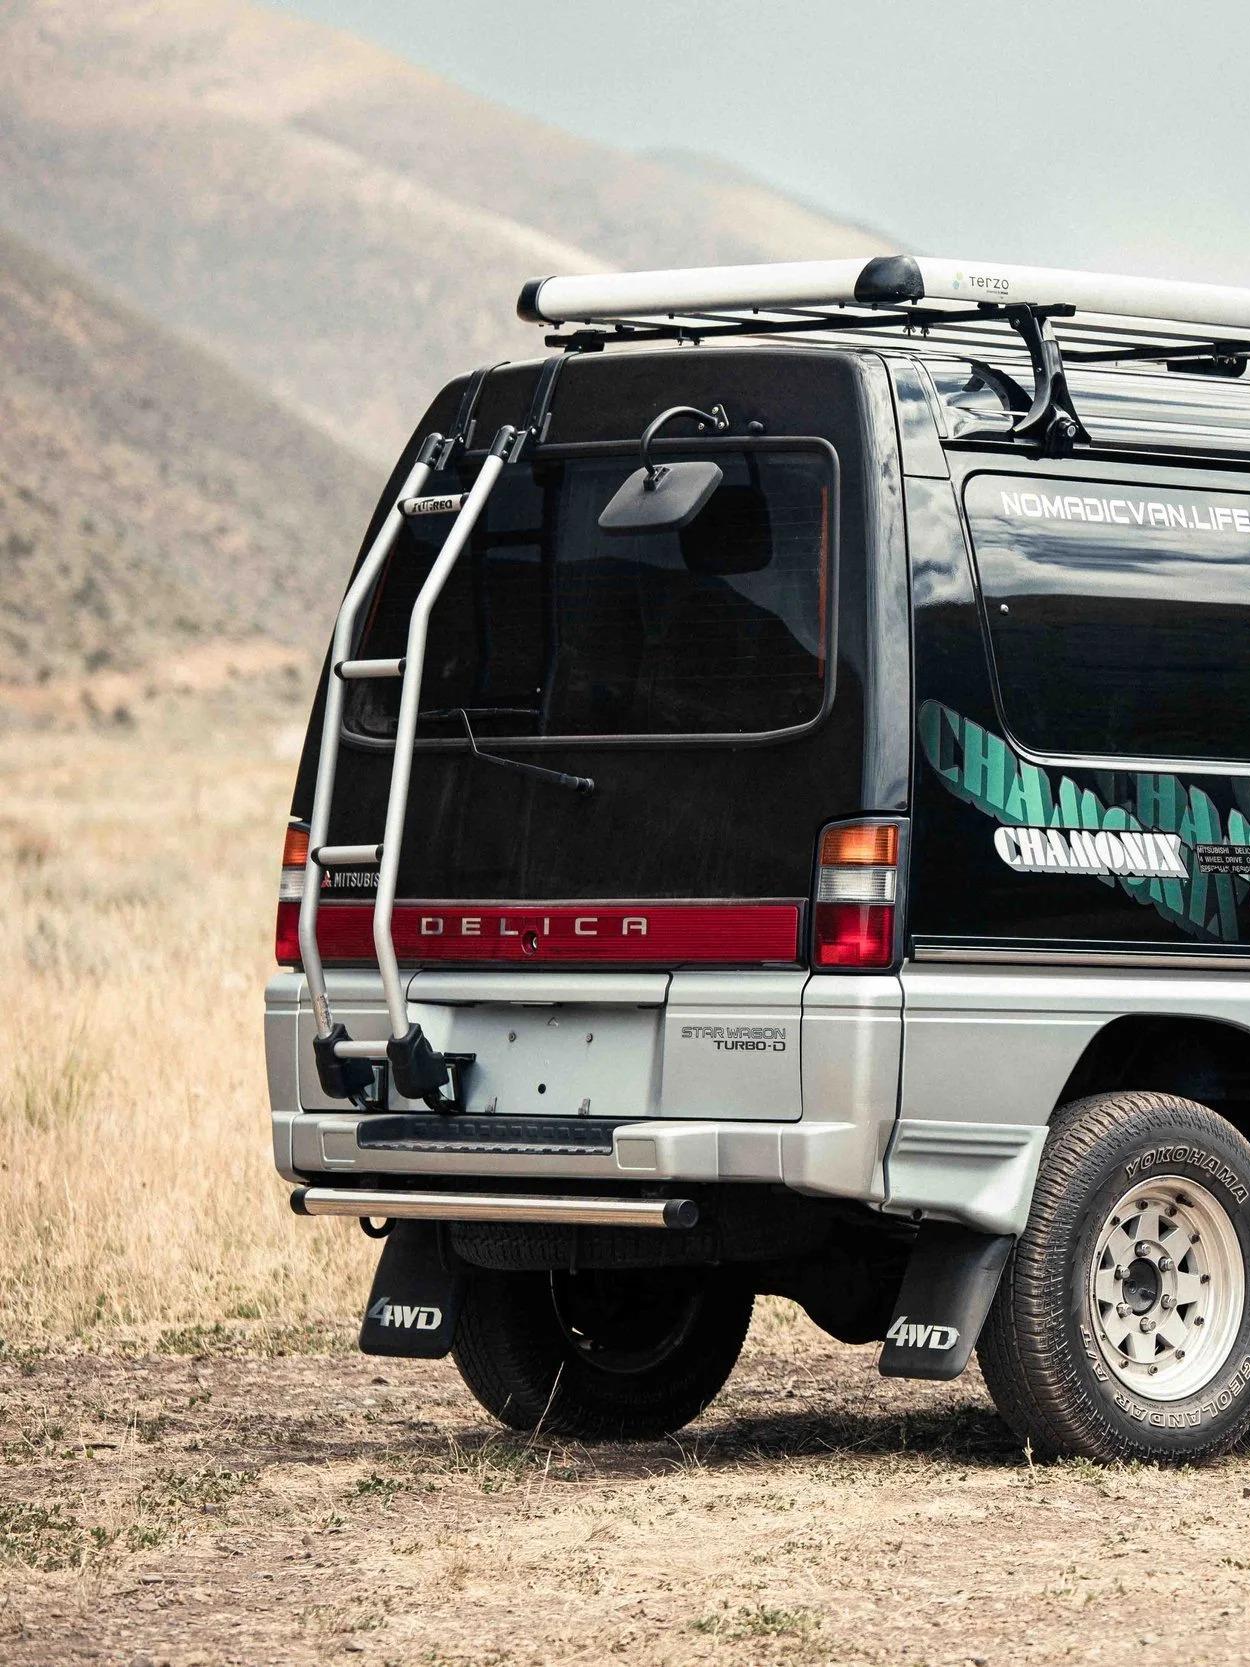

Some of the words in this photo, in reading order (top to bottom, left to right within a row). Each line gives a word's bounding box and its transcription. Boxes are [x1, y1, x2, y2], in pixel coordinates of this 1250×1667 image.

[969, 276, 1010, 290] Terzo
[993, 826, 1190, 879] CHAMONIX
[334, 872, 380, 888] MITSUBIS
[420, 917, 648, 936] DELICA
[681, 1026, 724, 1039] STAR
[726, 1027, 786, 1040] WAGON
[713, 1040, 786, 1052] TURBO-D
[1125, 1145, 1249, 1204] YOKOHAMA
[367, 1296, 443, 1330] 4WD
[886, 1315, 961, 1350] 4WD
